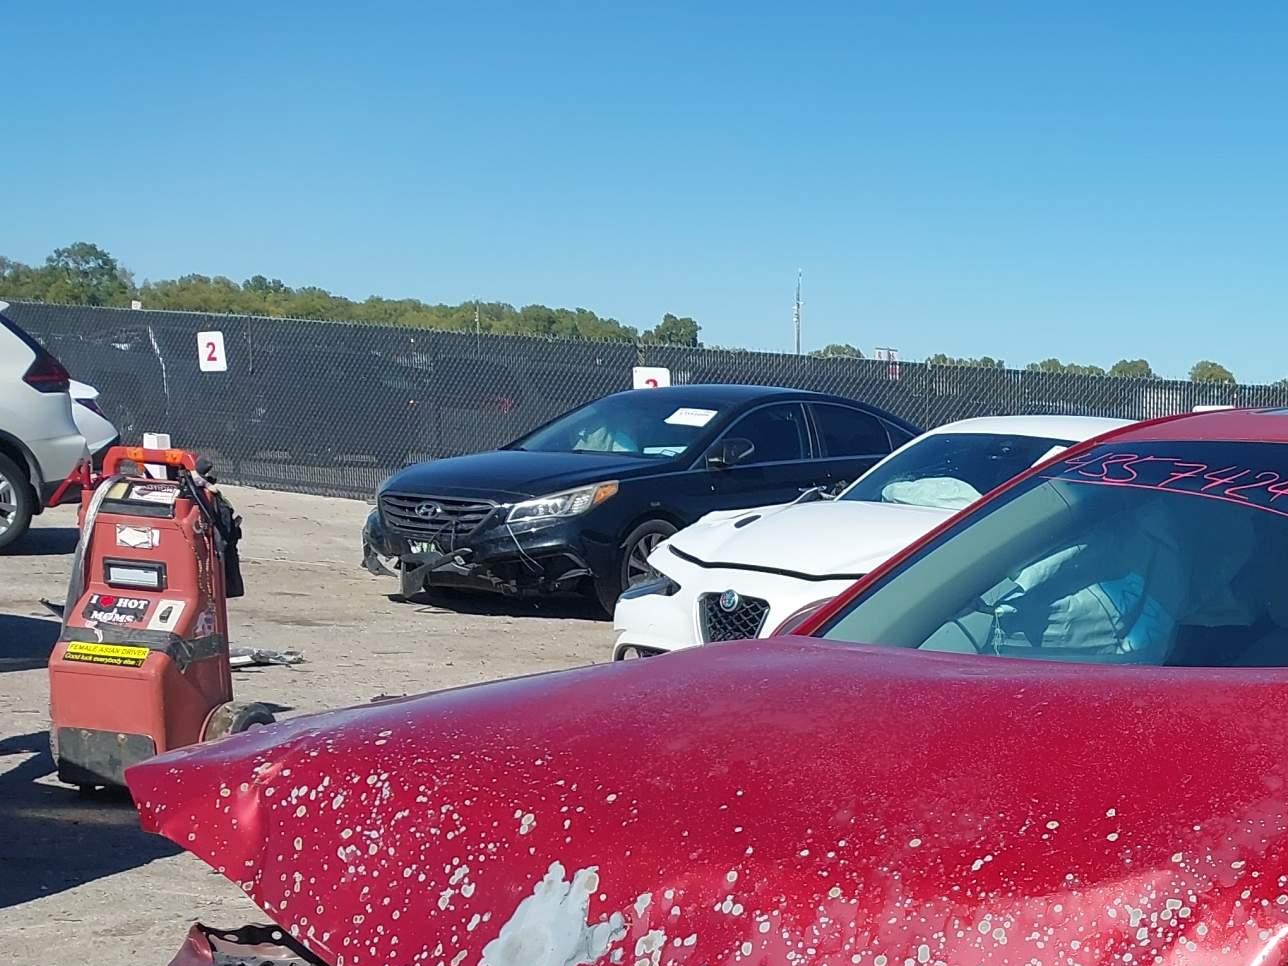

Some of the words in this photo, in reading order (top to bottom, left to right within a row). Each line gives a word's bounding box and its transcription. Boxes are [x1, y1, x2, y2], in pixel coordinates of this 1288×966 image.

[206, 342, 217, 361] 2
[90, 595, 100, 604] I
[116, 598, 149, 609] HOT
[69, 643, 99, 653] FEMALE
[99, 646, 121, 655] ASIAN
[120, 648, 148, 657] DRIVER
[64, 652, 81, 660] Good
[80, 654, 93, 662] luck
[93, 656, 122, 665] everybody
[122, 658, 136, 666] else
